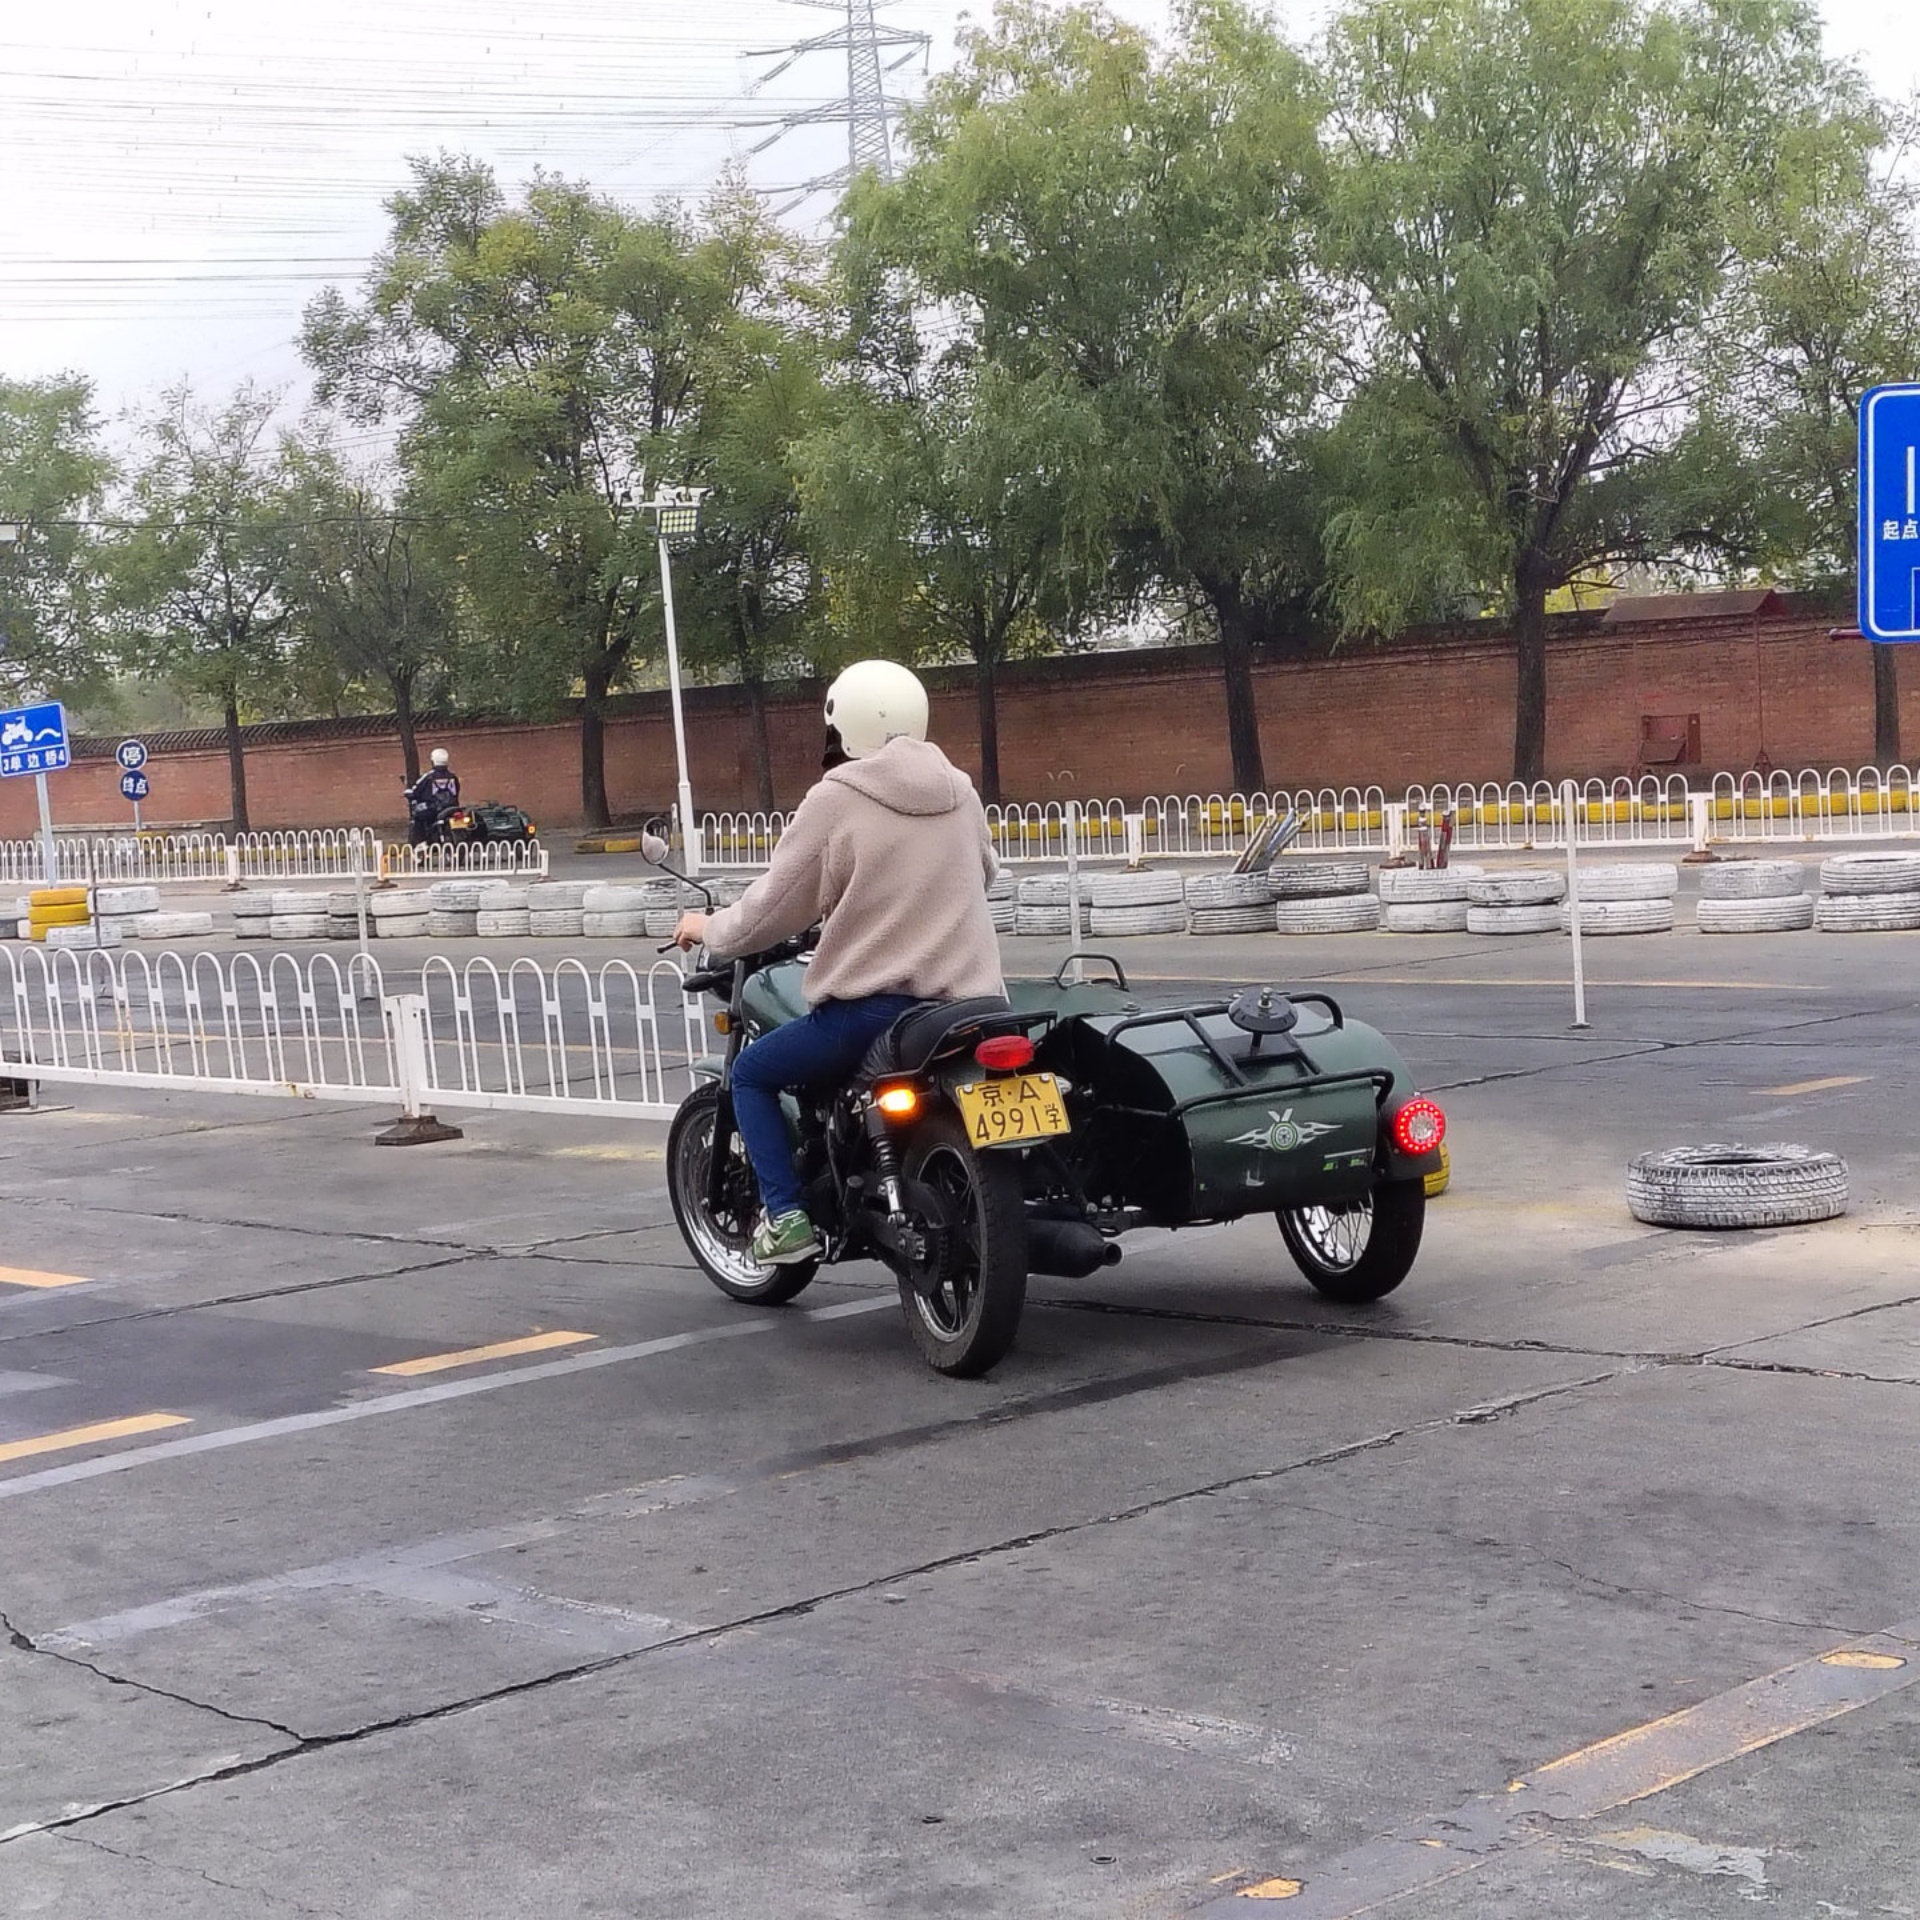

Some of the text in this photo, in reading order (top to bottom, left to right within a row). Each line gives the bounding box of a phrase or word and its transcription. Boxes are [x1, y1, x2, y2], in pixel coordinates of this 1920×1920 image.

[1883, 519, 1918, 540] 起点
[122, 746, 142, 765] 停
[122, 776, 147, 794] 终点
